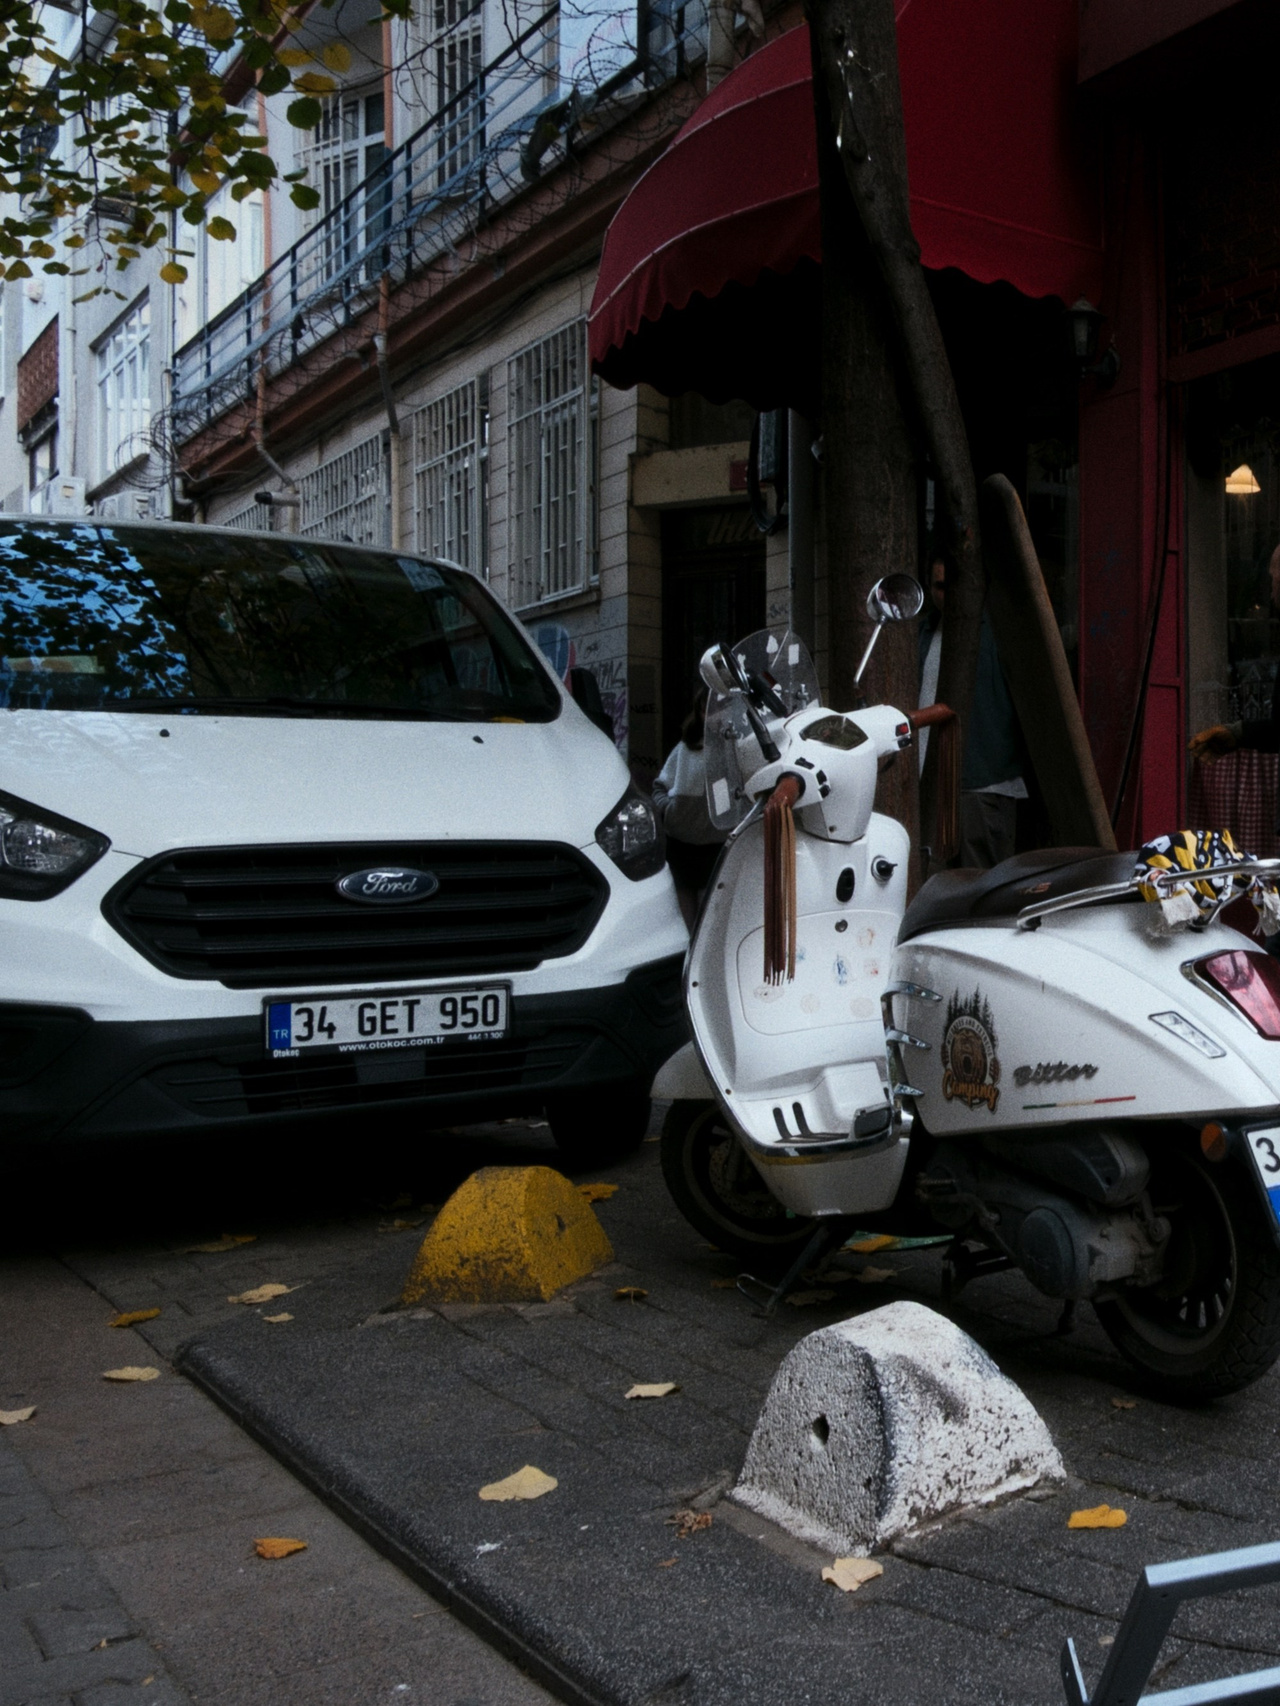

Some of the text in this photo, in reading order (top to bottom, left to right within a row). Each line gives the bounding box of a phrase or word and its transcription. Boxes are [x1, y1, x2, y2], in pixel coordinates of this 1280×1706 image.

[362, 872, 417, 894] Ford
[294, 994, 501, 1042] 34 GET 950
[273, 1028, 289, 1040] TR
[339, 1035, 445, 1053] www.otokoc.com.tr
[942, 1070, 999, 1112] Camping
